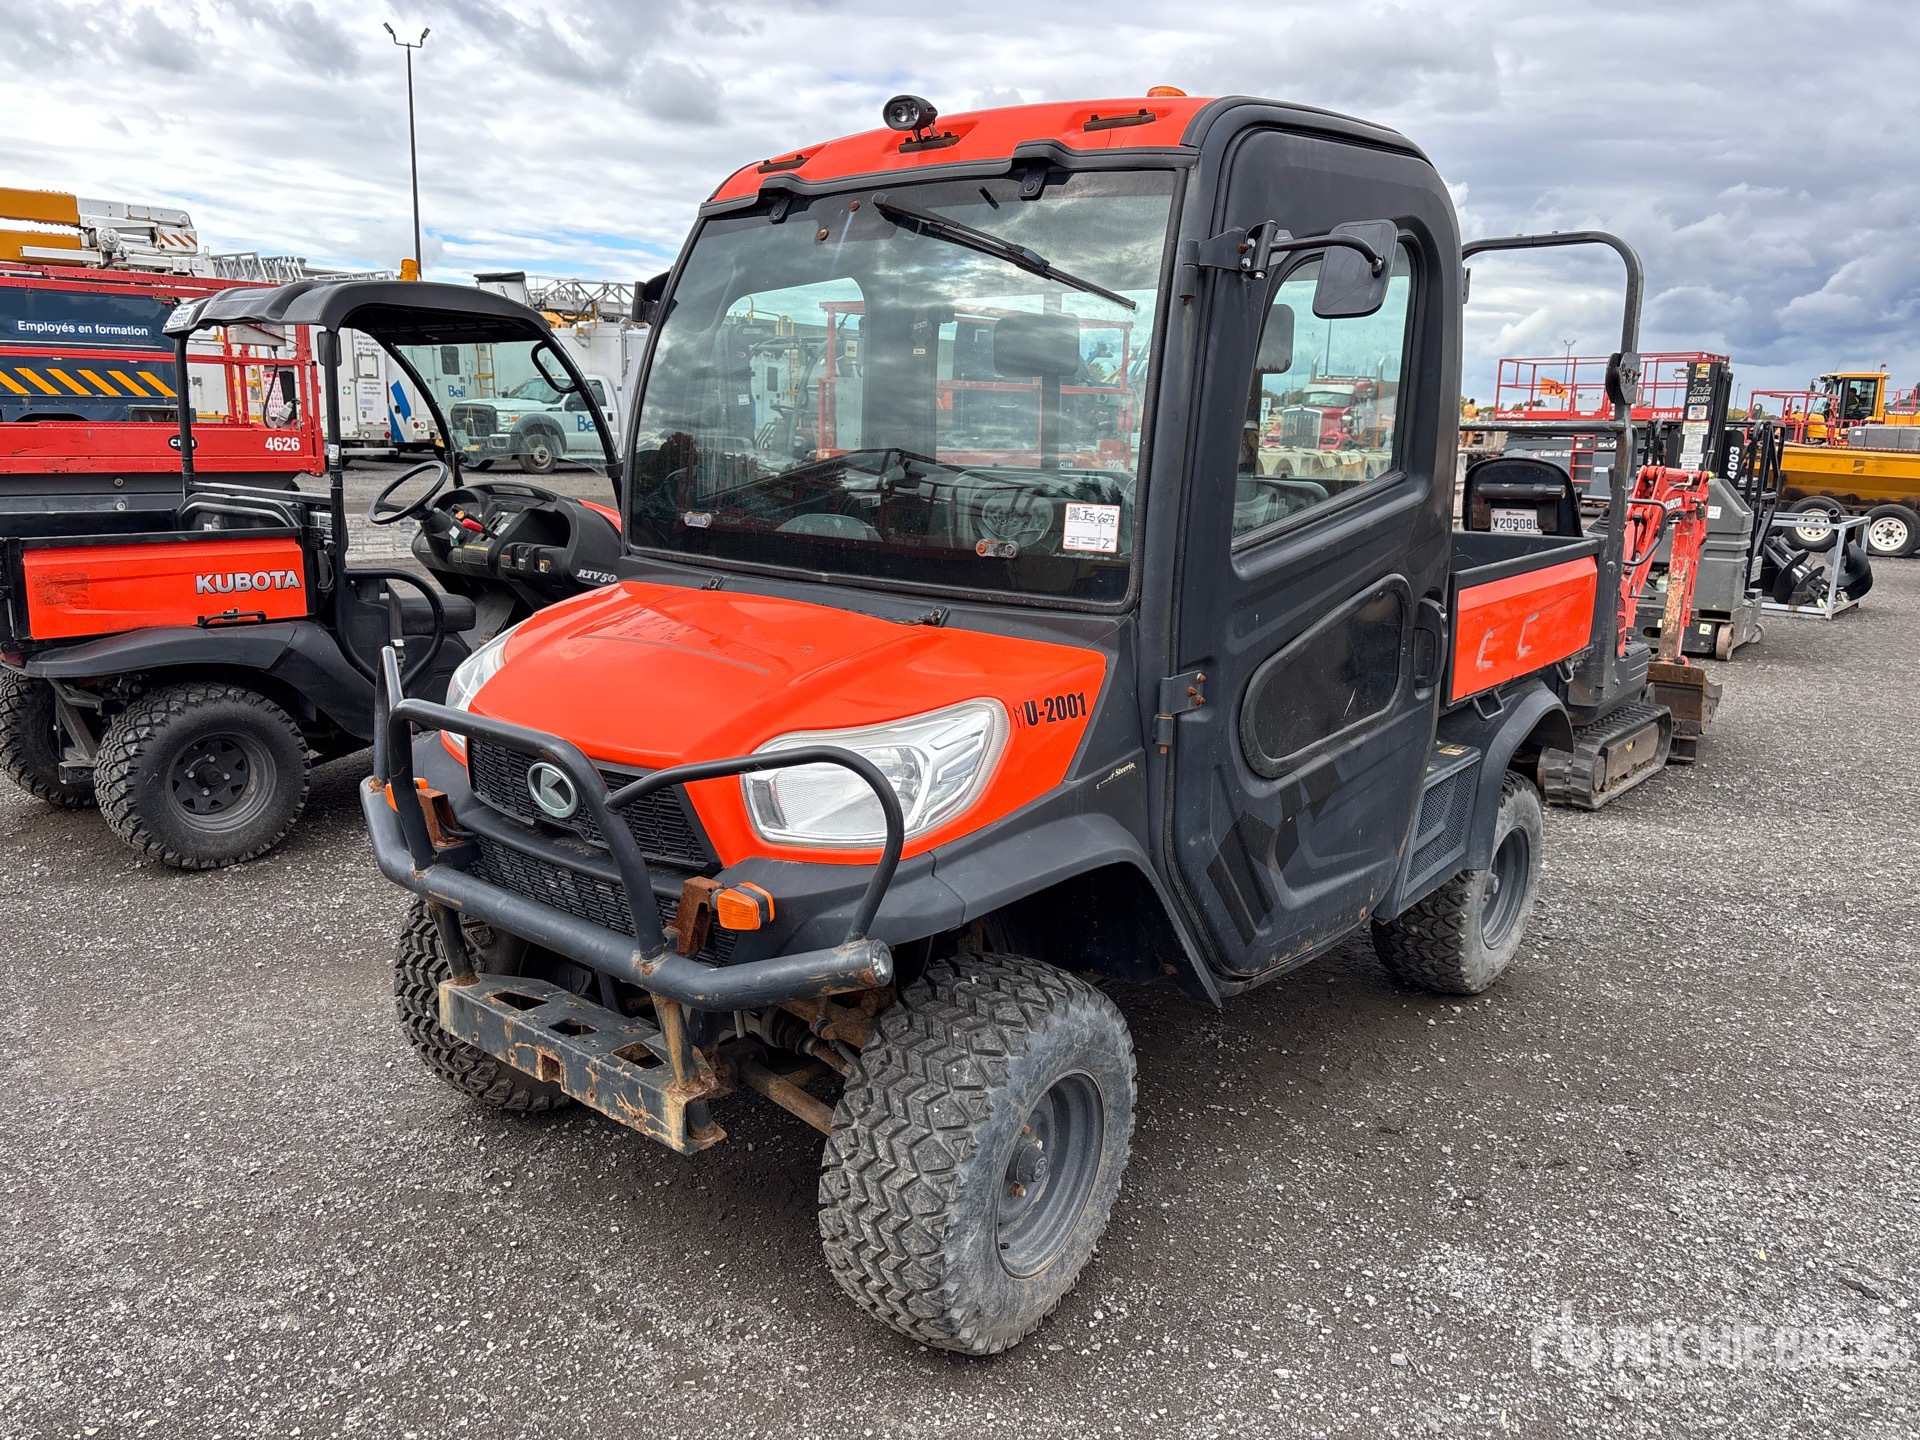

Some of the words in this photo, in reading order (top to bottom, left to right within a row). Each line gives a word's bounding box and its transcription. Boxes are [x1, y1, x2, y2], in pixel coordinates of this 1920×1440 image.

[17, 320, 76, 335] Employés
[78, 325, 93, 334] en
[95, 325, 149, 336] formation
[447, 384, 466, 398] Bell
[1651, 411, 1676, 419] SJ8841
[577, 414, 597, 433] Be
[265, 437, 300, 451] 4626
[1727, 446, 1740, 479] 4003
[195, 569, 302, 595] KUBOTA
[576, 568, 618, 584] RTV50
[1115, 761, 1137, 777] Steerin
